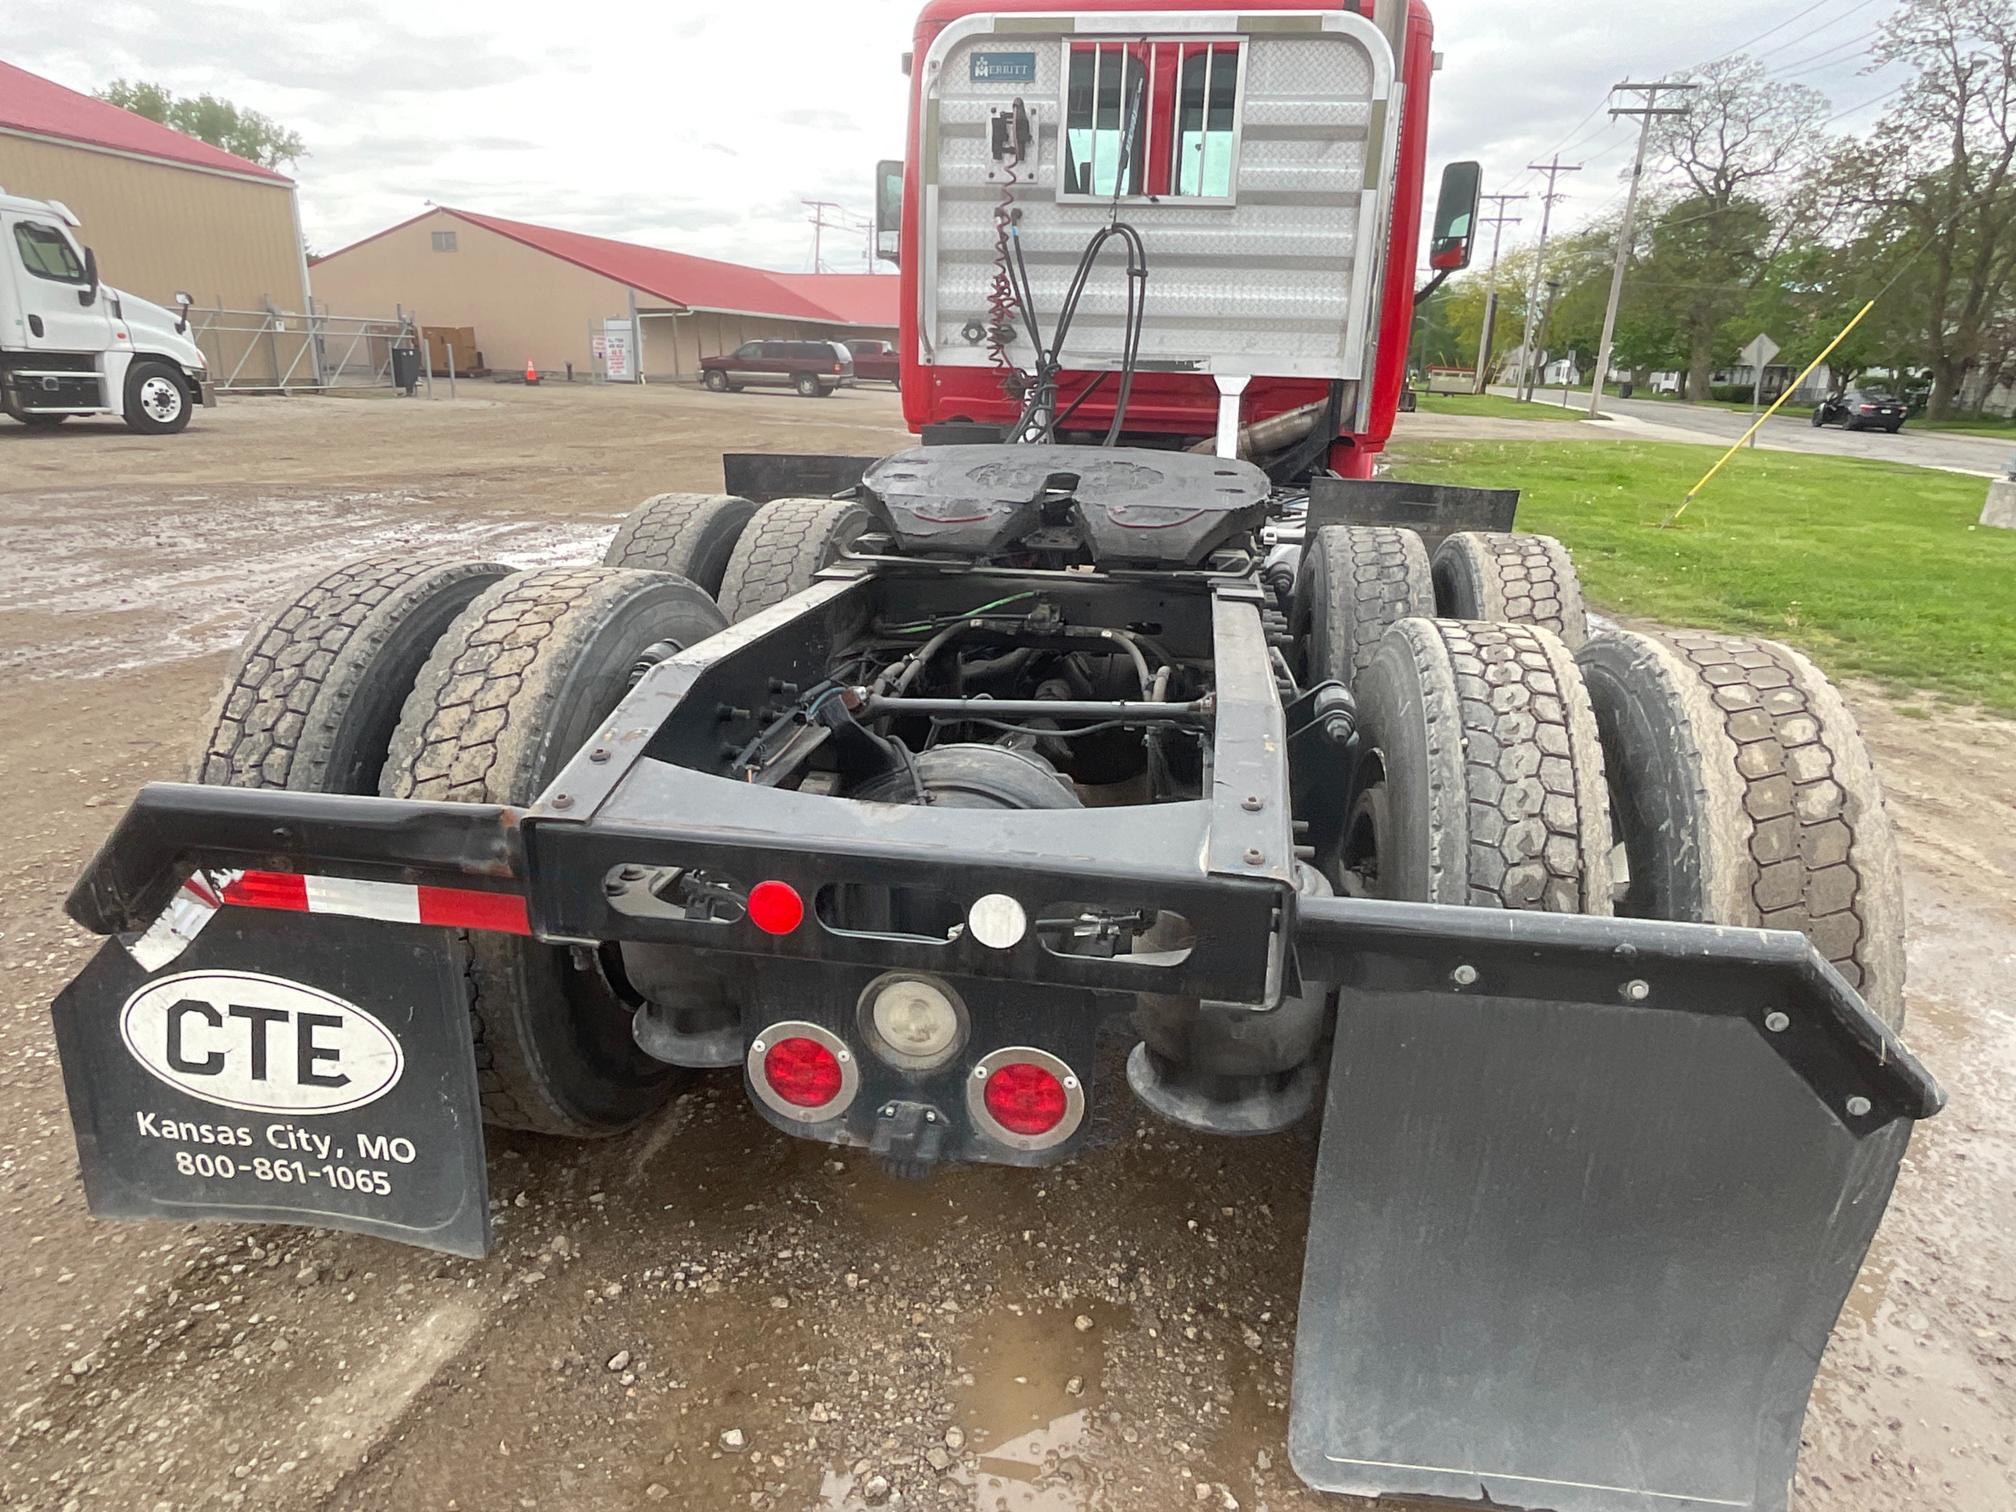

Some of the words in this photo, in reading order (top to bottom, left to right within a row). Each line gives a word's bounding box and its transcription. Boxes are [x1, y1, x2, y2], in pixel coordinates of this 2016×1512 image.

[166, 999, 352, 1088] CTE
[136, 1111, 252, 1147] Kansas
[266, 1124, 343, 1159] City,
[357, 1133, 416, 1163] MO
[175, 1152, 392, 1196] 800-861-1065
